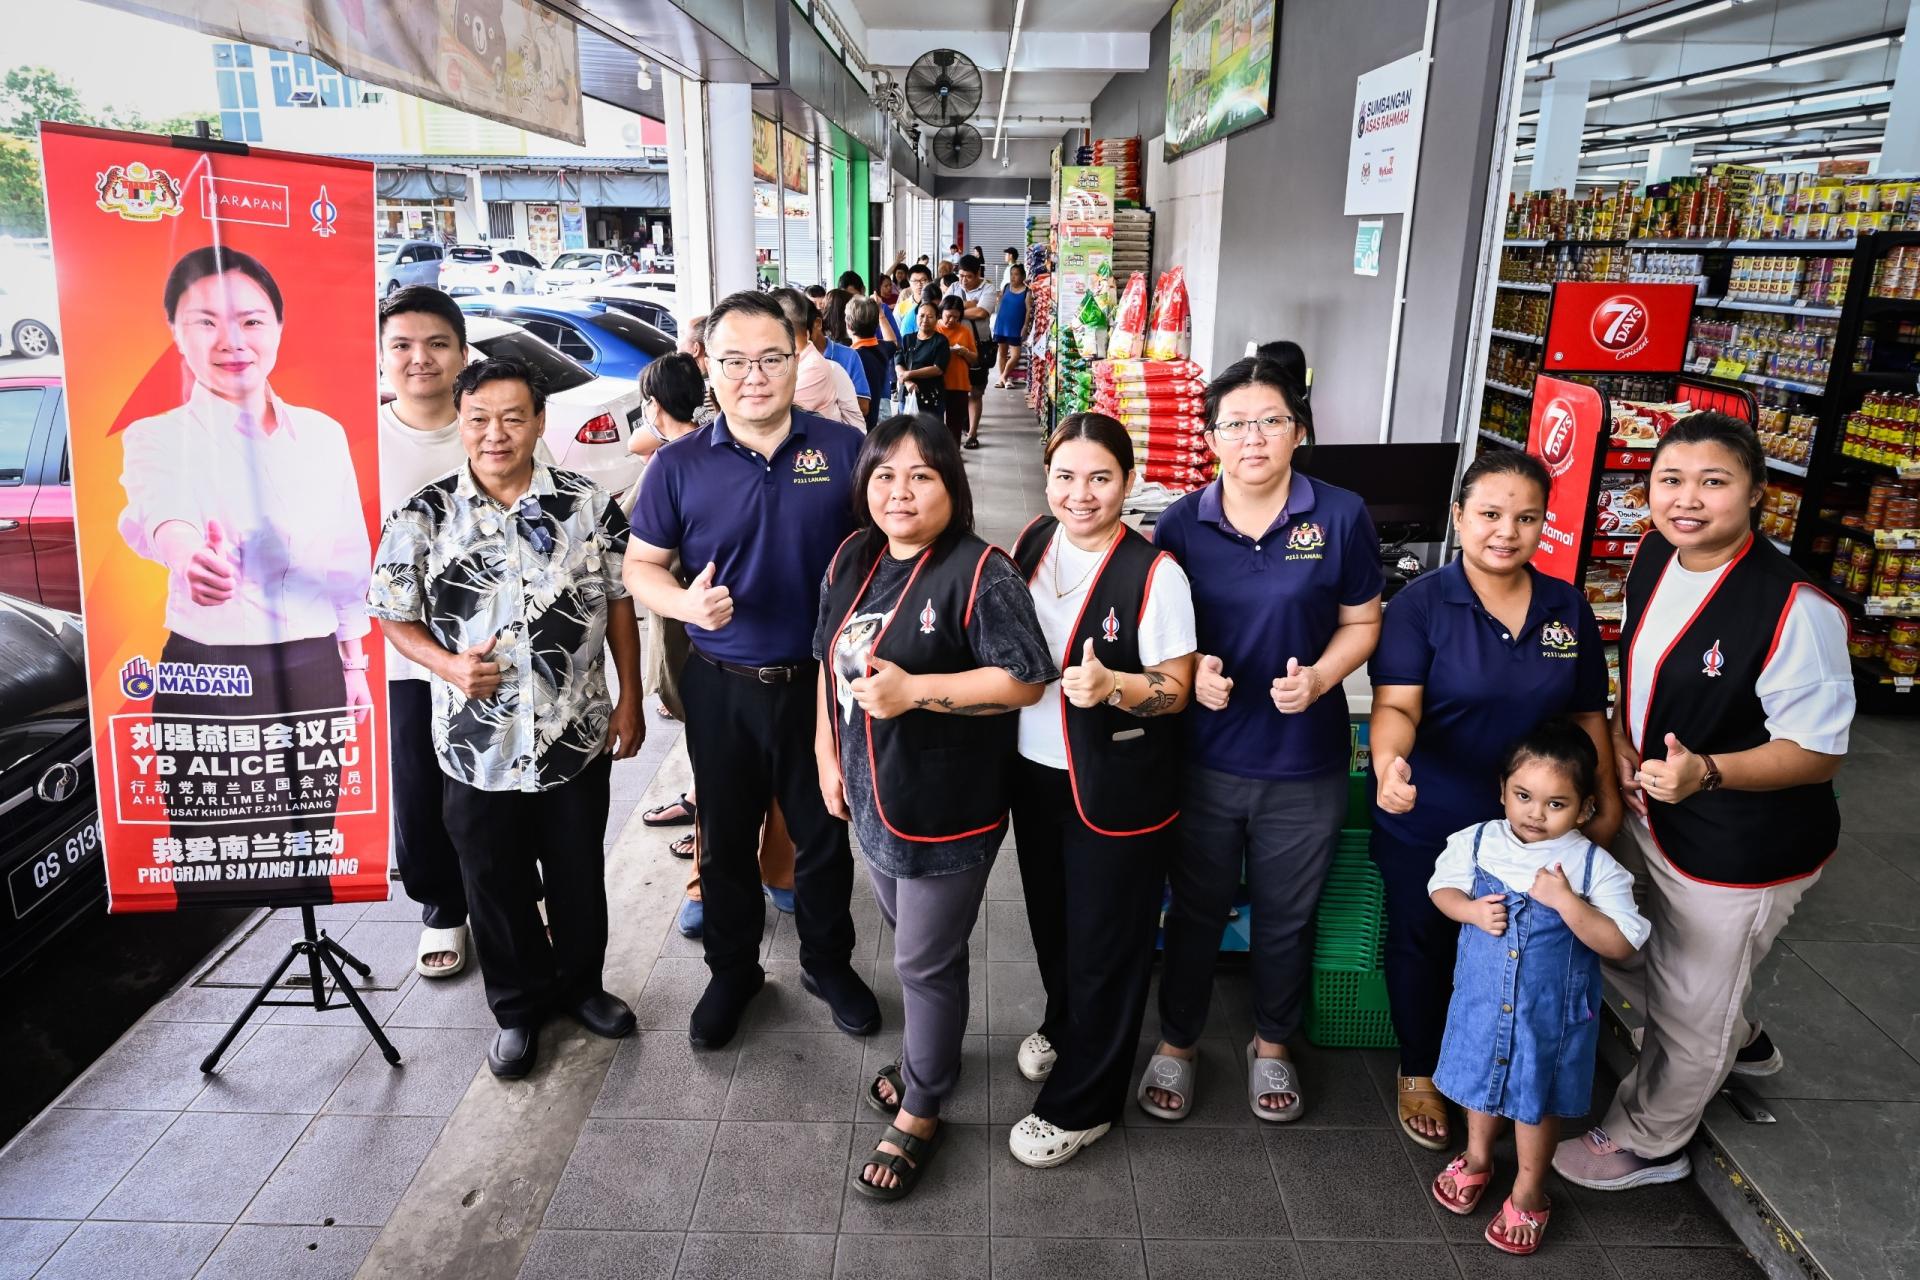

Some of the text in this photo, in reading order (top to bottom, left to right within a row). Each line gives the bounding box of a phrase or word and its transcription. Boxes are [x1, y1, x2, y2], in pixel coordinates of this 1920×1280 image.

[1367, 88, 1412, 117] SUMBANGAN
[1365, 109, 1409, 133] ASAS RAHMAH
[1602, 303, 1636, 344] 7
[1615, 307, 1644, 343] DAYS
[1616, 336, 1650, 361] Croissant
[1545, 406, 1568, 455] 7
[1551, 415, 1573, 457] DAYS
[1599, 513, 1615, 531] 7
[1617, 510, 1642, 519] Double
[1542, 522, 1574, 546] Ramai
[158, 664, 249, 679] MALAYSIA
[159, 676, 250, 694] MADANI
[130, 716, 358, 752] 刘强燕国会议员
[131, 746, 360, 776] YB ALICE LAU
[130, 771, 362, 795] 行动党南兰区国会议员
[132, 786, 361, 806] AHLI PARLIMEN LANANG
[163, 800, 332, 817] PUSAT KHIDMAT P.211 LANANG
[152, 828, 345, 864] 我爱南兰活动
[33, 852, 61, 888] QS
[138, 858, 359, 883] PROGRAM SAYANGI LANANG
